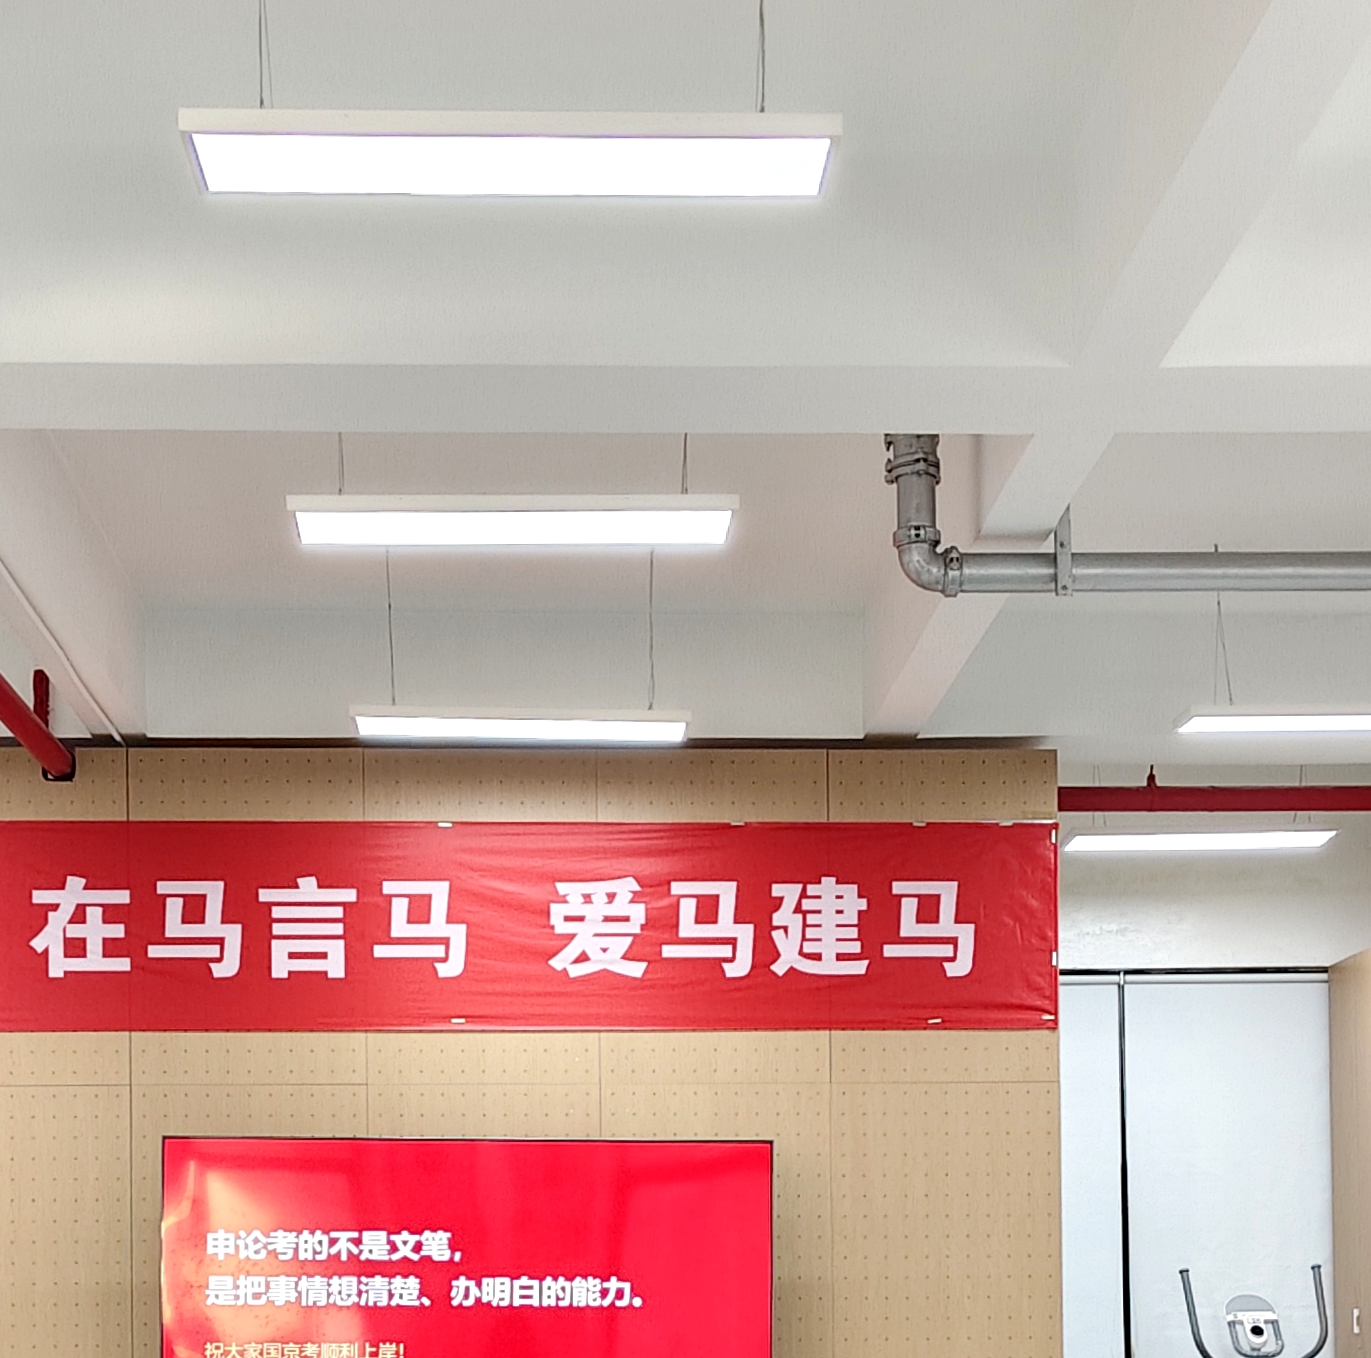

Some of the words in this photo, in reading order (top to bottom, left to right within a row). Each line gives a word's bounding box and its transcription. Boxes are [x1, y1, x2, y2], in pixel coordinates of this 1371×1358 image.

[30, 875, 467, 980] 在马言马
[547, 876, 975, 979] 爱马建马
[206, 1229, 461, 1262] 申论考的不是文笔，
[205, 1275, 643, 1307] 是把事情想清楚、办明白的能力。
